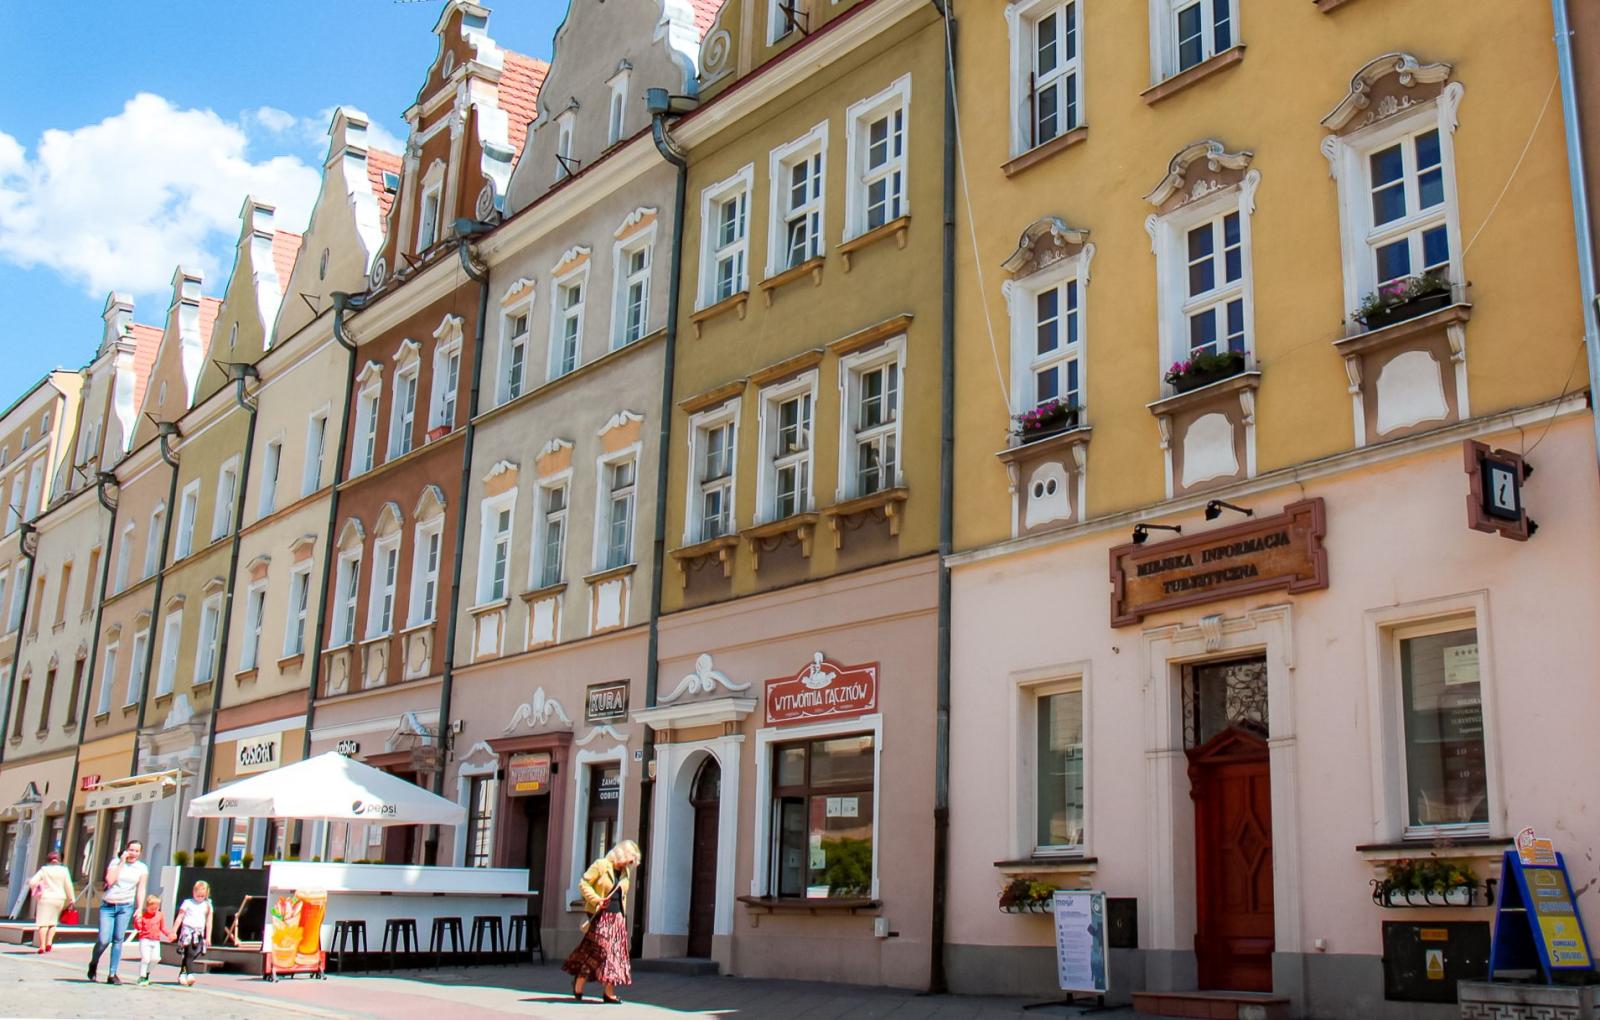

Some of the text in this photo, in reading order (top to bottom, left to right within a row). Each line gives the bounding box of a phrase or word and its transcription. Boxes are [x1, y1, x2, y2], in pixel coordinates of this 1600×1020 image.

[1136, 531, 1291, 577] MIEJSKA INFORMACJA
[1163, 563, 1259, 594] TURYSTYCZNA
[591, 690, 623, 712] KURA
[774, 690, 823, 711] WYTWÓRNIA
[368, 803, 397, 815] pepsi
